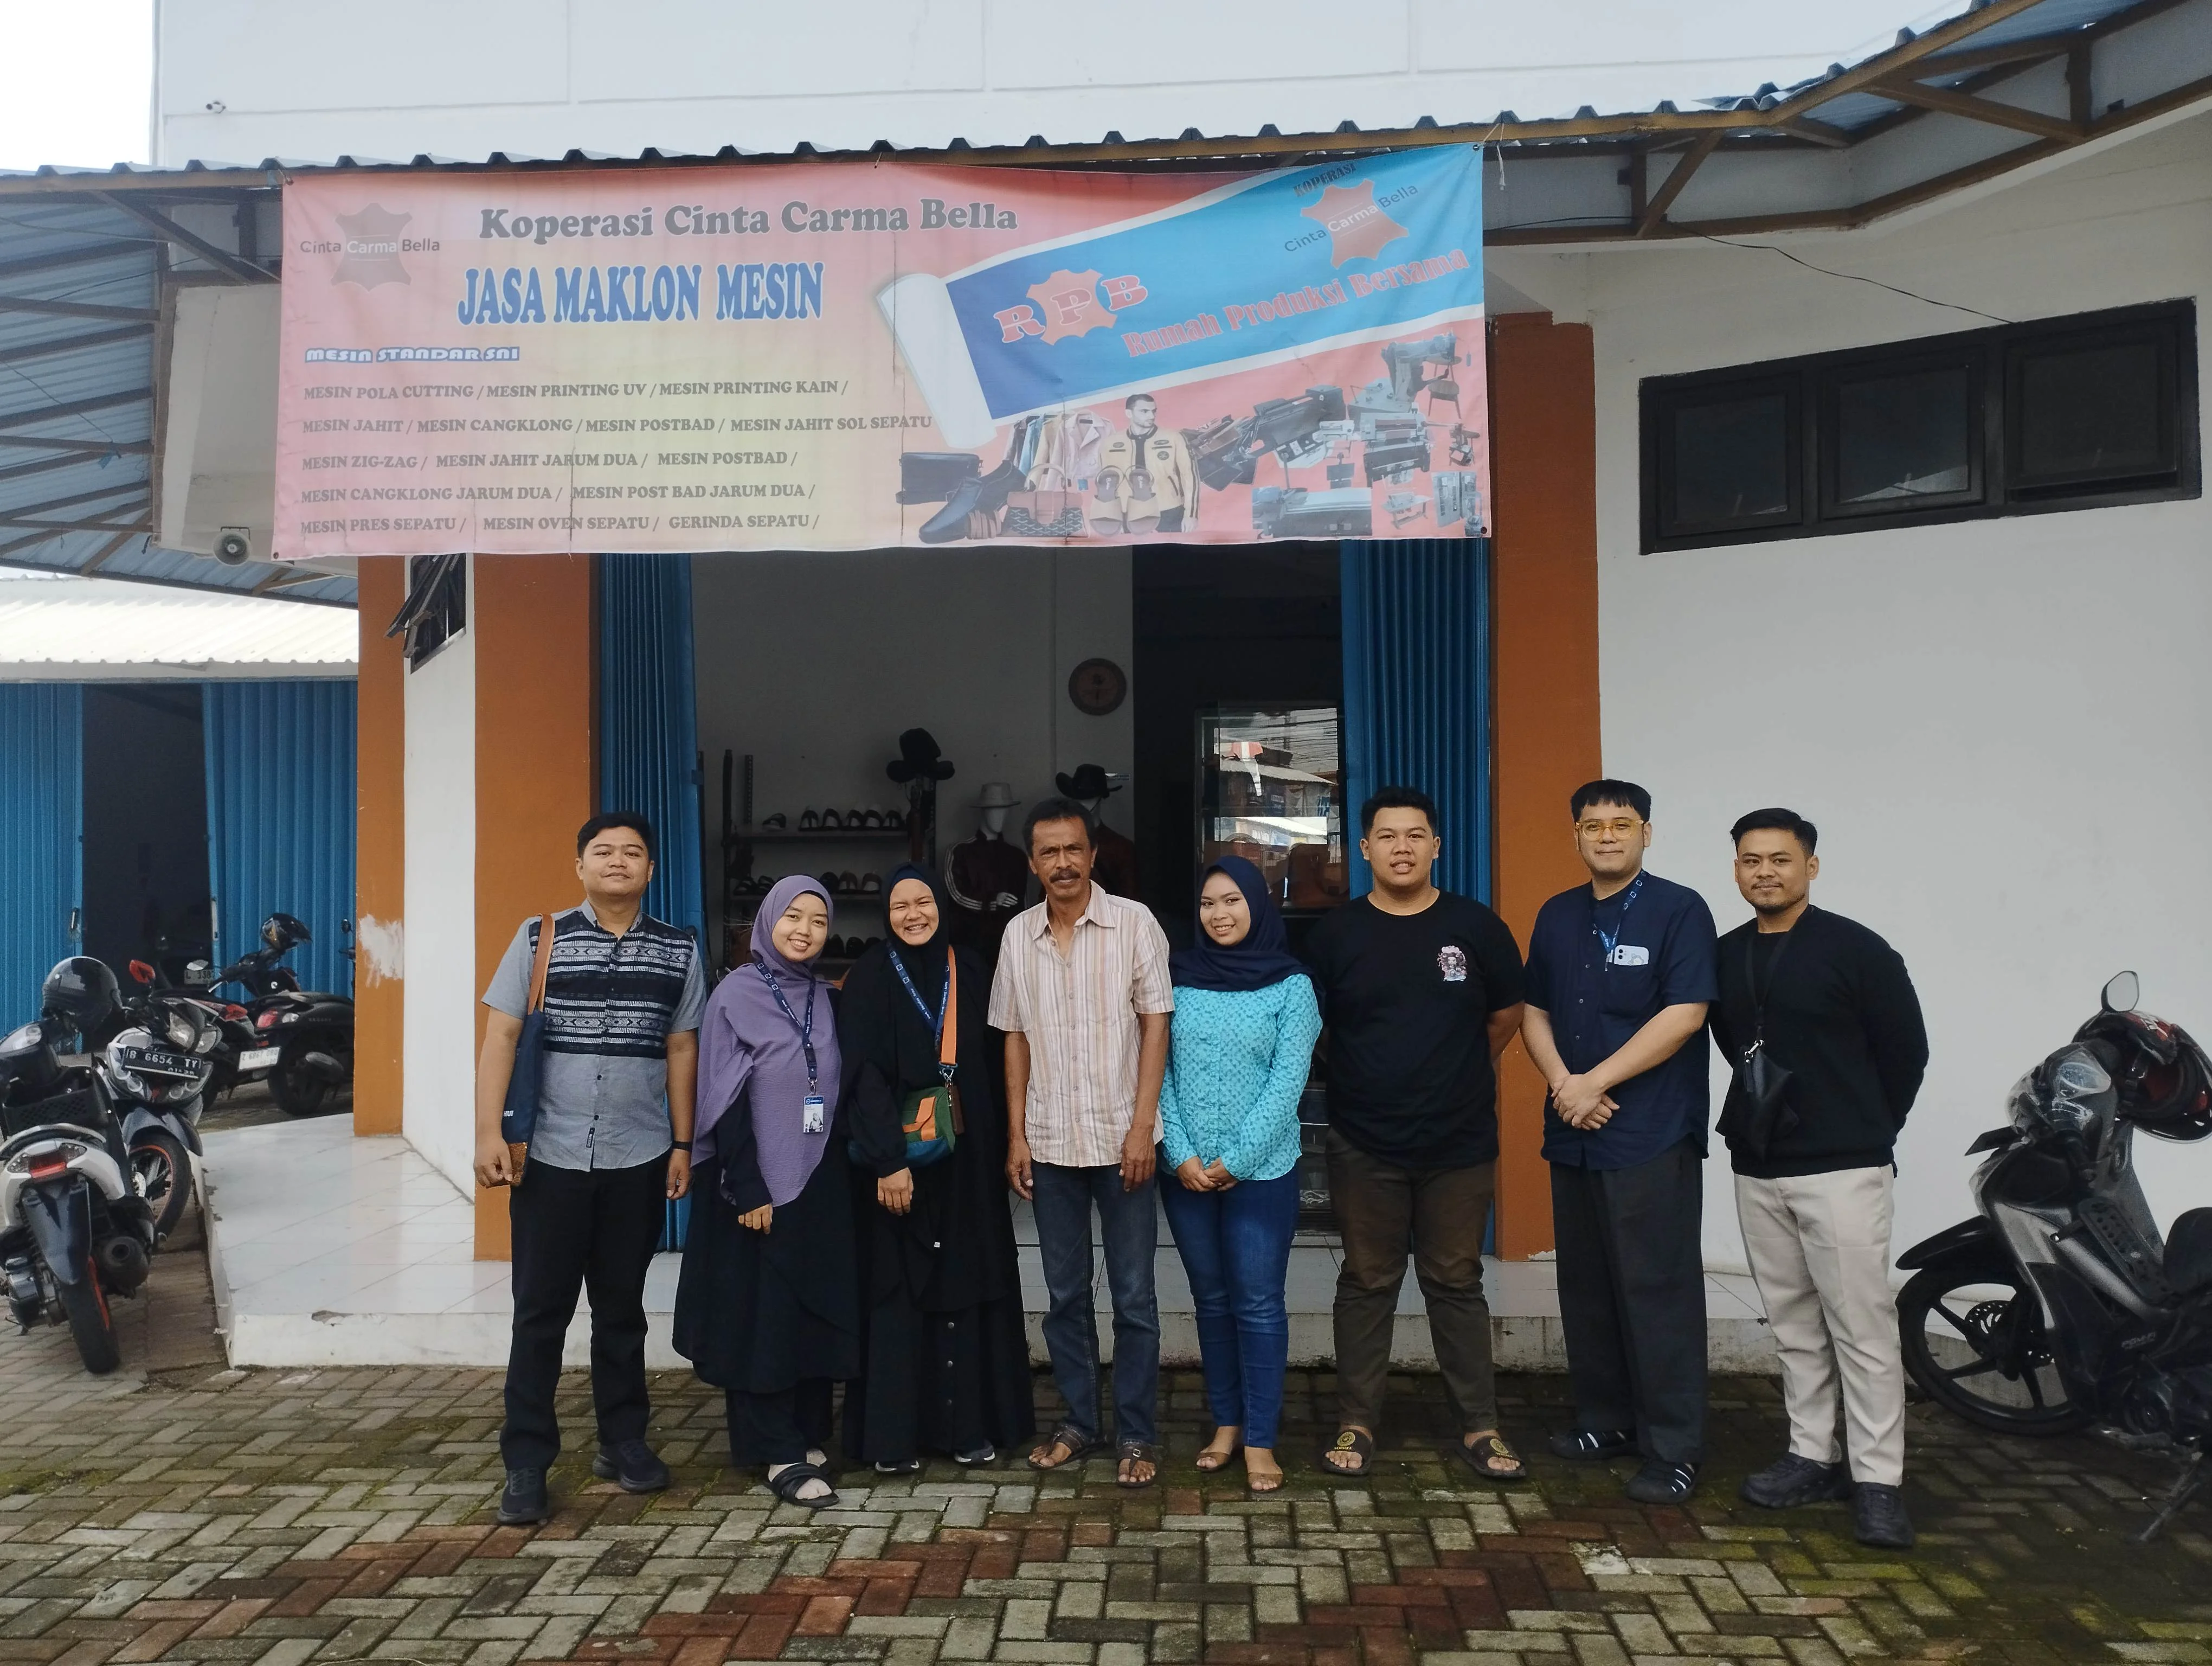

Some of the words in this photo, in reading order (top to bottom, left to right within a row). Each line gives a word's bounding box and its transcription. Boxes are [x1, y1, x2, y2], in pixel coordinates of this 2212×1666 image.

[479, 206, 653, 245] Koperasi
[665, 204, 770, 235] Cinta
[782, 201, 909, 232] Carma
[920, 198, 1018, 229] Bella
[1284, 230, 1327, 252] Cinta
[1328, 205, 1379, 232] Carma
[1378, 185, 1418, 208] Bella
[300, 241, 341, 253] Cinta
[347, 241, 397, 253] Carma
[402, 239, 440, 252] Bella
[458, 268, 545, 325] JASA
[554, 265, 702, 323] MAKLON
[716, 262, 824, 321] MESIN
[1122, 313, 1223, 357] Rumah
[1223, 278, 1348, 330] Produksi
[1348, 249, 1470, 299] Bersama
[304, 386, 352, 400] MESIN
[357, 387, 398, 400] POLA
[402, 386, 474, 398] CUTTING
[487, 385, 536, 398] MESIN
[541, 384, 619, 397] PRINTING
[623, 383, 647, 395] UV
[660, 382, 710, 395] MESIN
[714, 381, 792, 394] PRINTING
[796, 381, 838, 393] KAIN
[303, 419, 349, 433] MESIN
[353, 420, 403, 432] JAHIT
[417, 420, 466, 433] MESIN
[471, 419, 573, 431] CANGKLONG
[586, 419, 635, 433] MESIN
[640, 419, 715, 431] POSTBAD
[730, 419, 781, 432] MESIN
[785, 418, 833, 431] JAHIT
[837, 418, 867, 430] SOL
[871, 416, 932, 429] SEPATU
[302, 456, 348, 470] MESIN
[351, 456, 417, 468] ZIG-ZAG
[436, 455, 486, 467] MESIN
[490, 454, 539, 467] JAHIT
[542, 454, 599, 466] JARUM
[603, 454, 638, 466] DUA
[658, 452, 708, 465] MESIN
[712, 452, 787, 465] POSTBAD
[301, 489, 346, 503] MESIN
[350, 489, 452, 501] CANGKLONG
[456, 488, 513, 500] JARUM
[517, 487, 552, 499] DUA
[573, 486, 623, 499] MESIN
[627, 486, 668, 498] POST
[672, 486, 706, 498] BAD
[710, 485, 766, 498] JARUM
[770, 484, 805, 497] DUA
[300, 520, 346, 534] MESIN
[350, 518, 389, 531] PRES
[393, 518, 455, 530] SEPATU
[484, 518, 533, 530] MESIN
[538, 517, 583, 530] OVEN
[587, 517, 650, 529] SEPATU
[669, 516, 743, 529] GERINDA
[747, 515, 809, 527] SEPATU
[130, 1050, 137, 1059] B
[145, 1053, 172, 1065] 6654
[184, 1058, 197, 1068] TY
